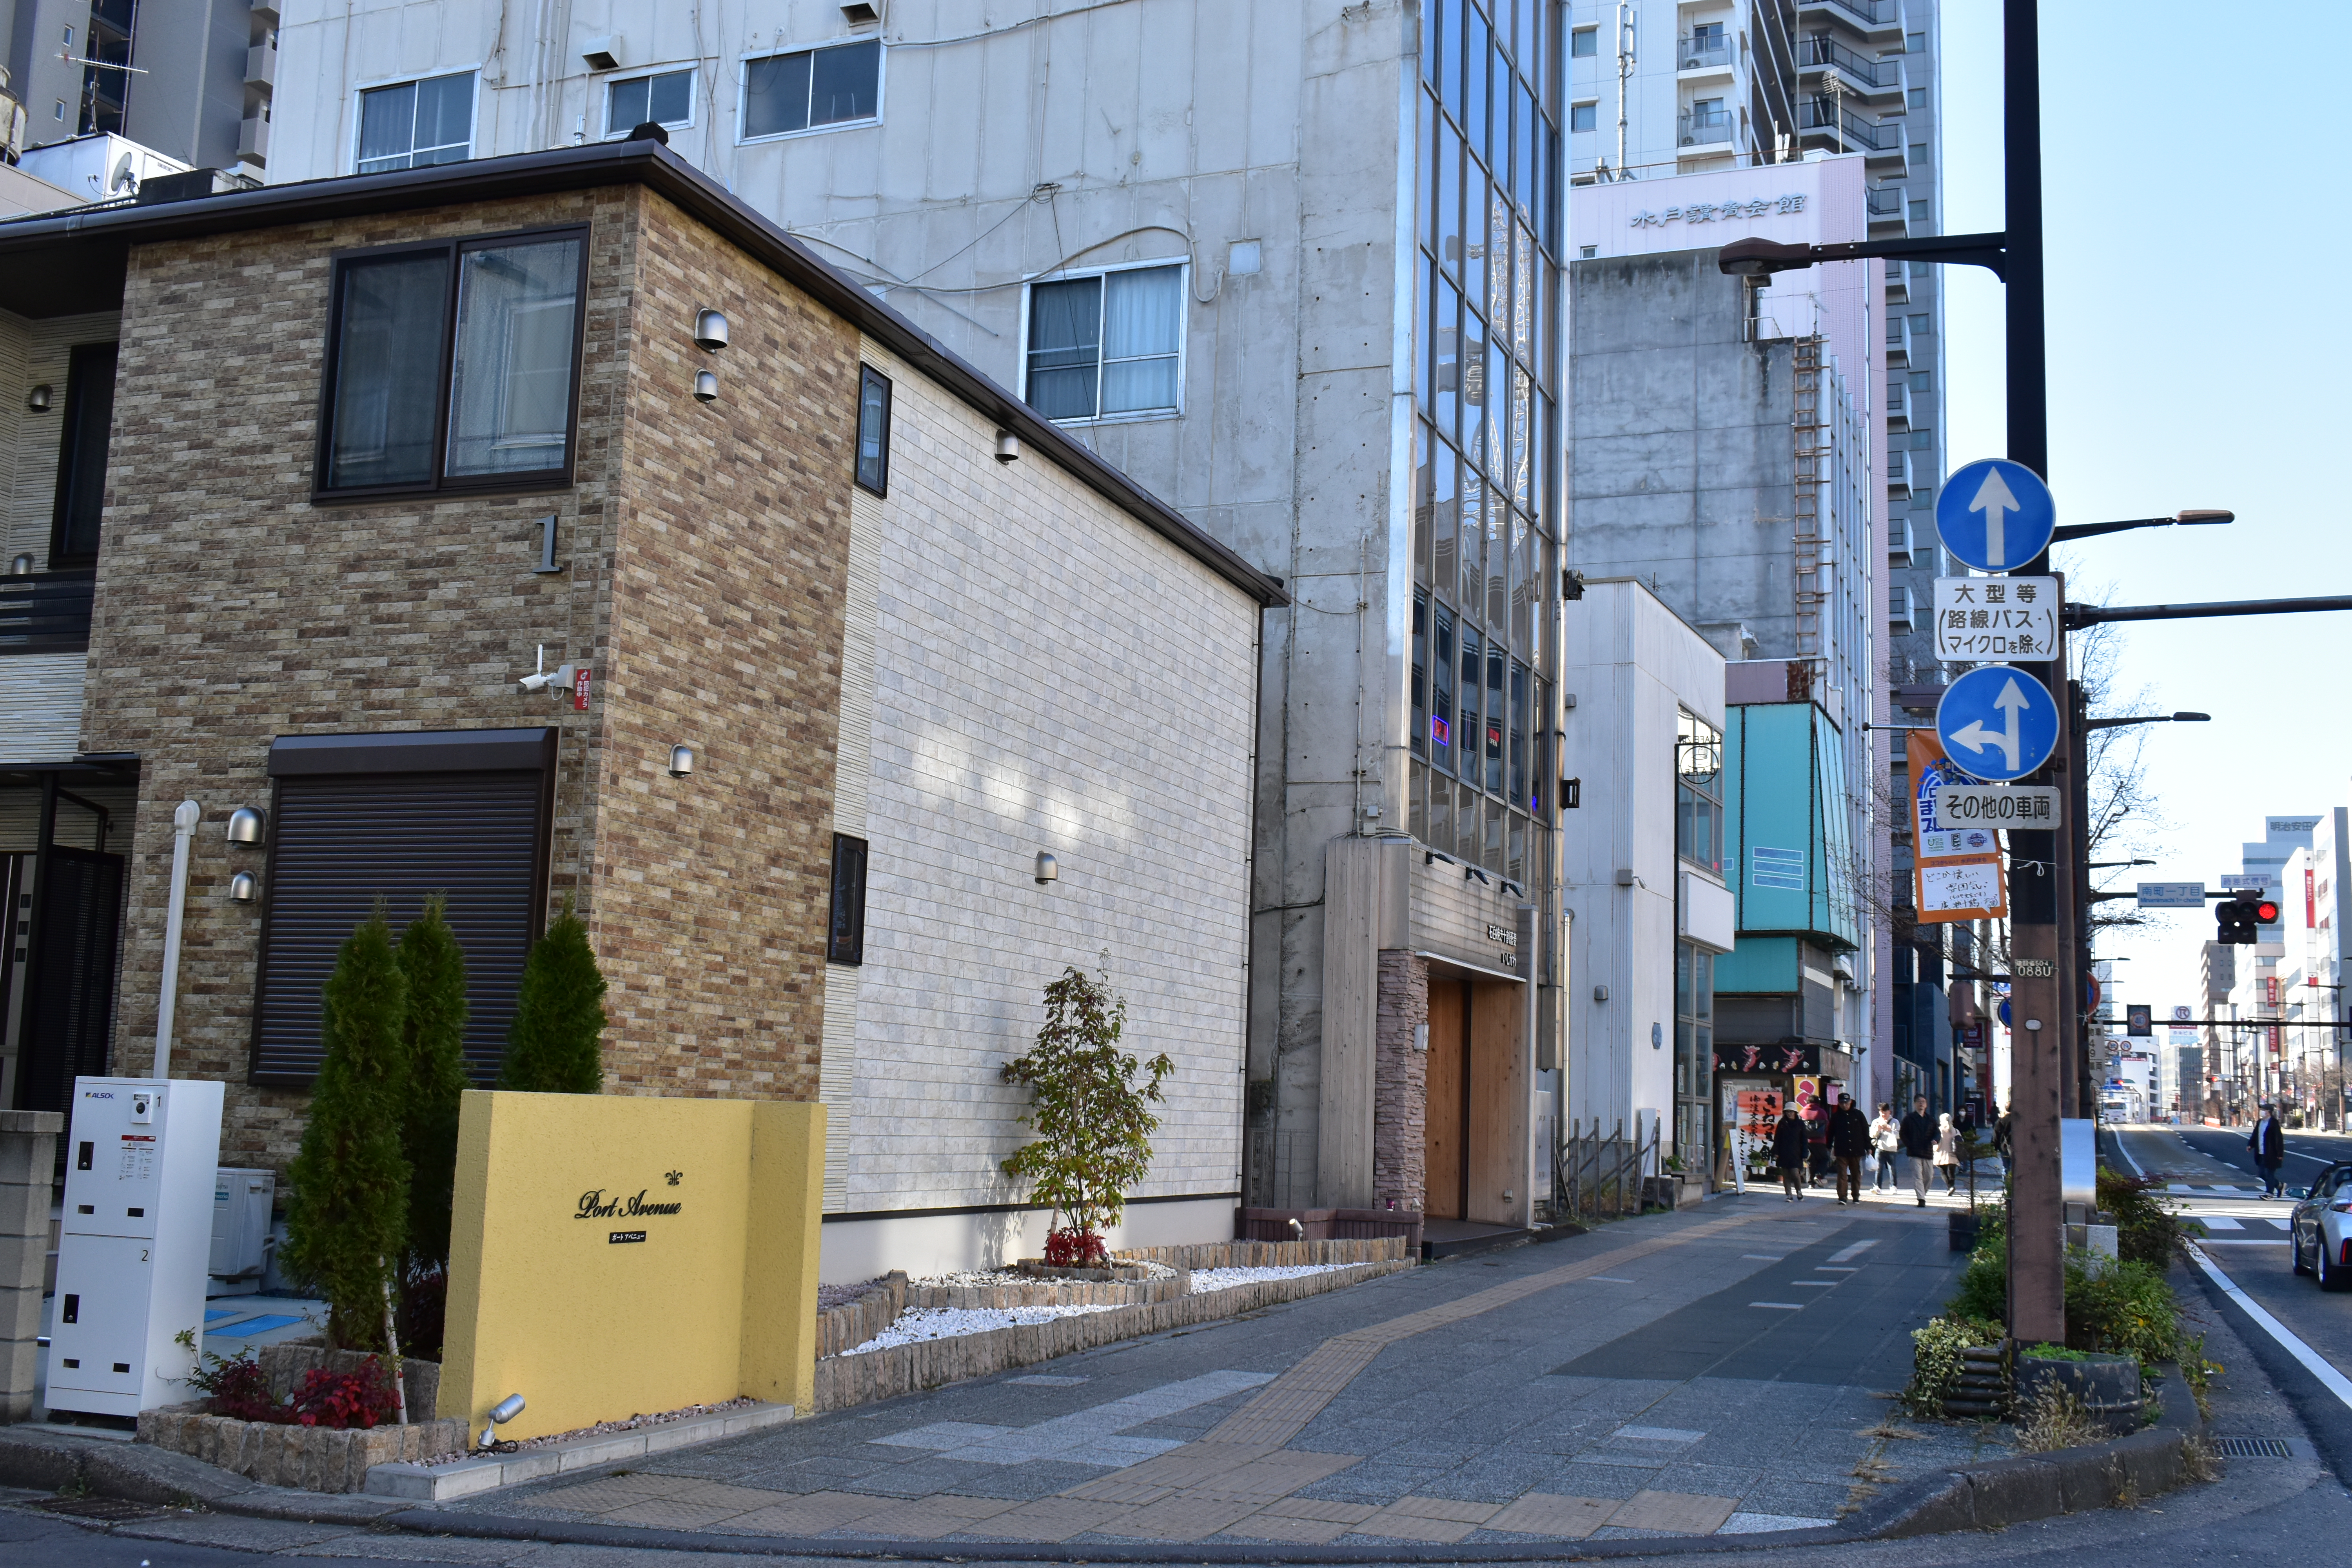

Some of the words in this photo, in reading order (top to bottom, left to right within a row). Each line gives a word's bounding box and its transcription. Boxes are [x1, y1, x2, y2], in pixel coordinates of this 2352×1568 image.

[1955, 584, 2036, 603] 大型等
[1946, 795, 2049, 819] その他の車両
[2142, 886, 2200, 896] 南町一丁目
[2018, 966, 2051, 976] 088U
[157, 1096, 161, 1107] 1
[1738, 1128, 1747, 1160] ミナミ
[574, 1189, 619, 1219] Port
[618, 1189, 682, 1216] Avenue
[142, 1249, 149, 1261] 2
